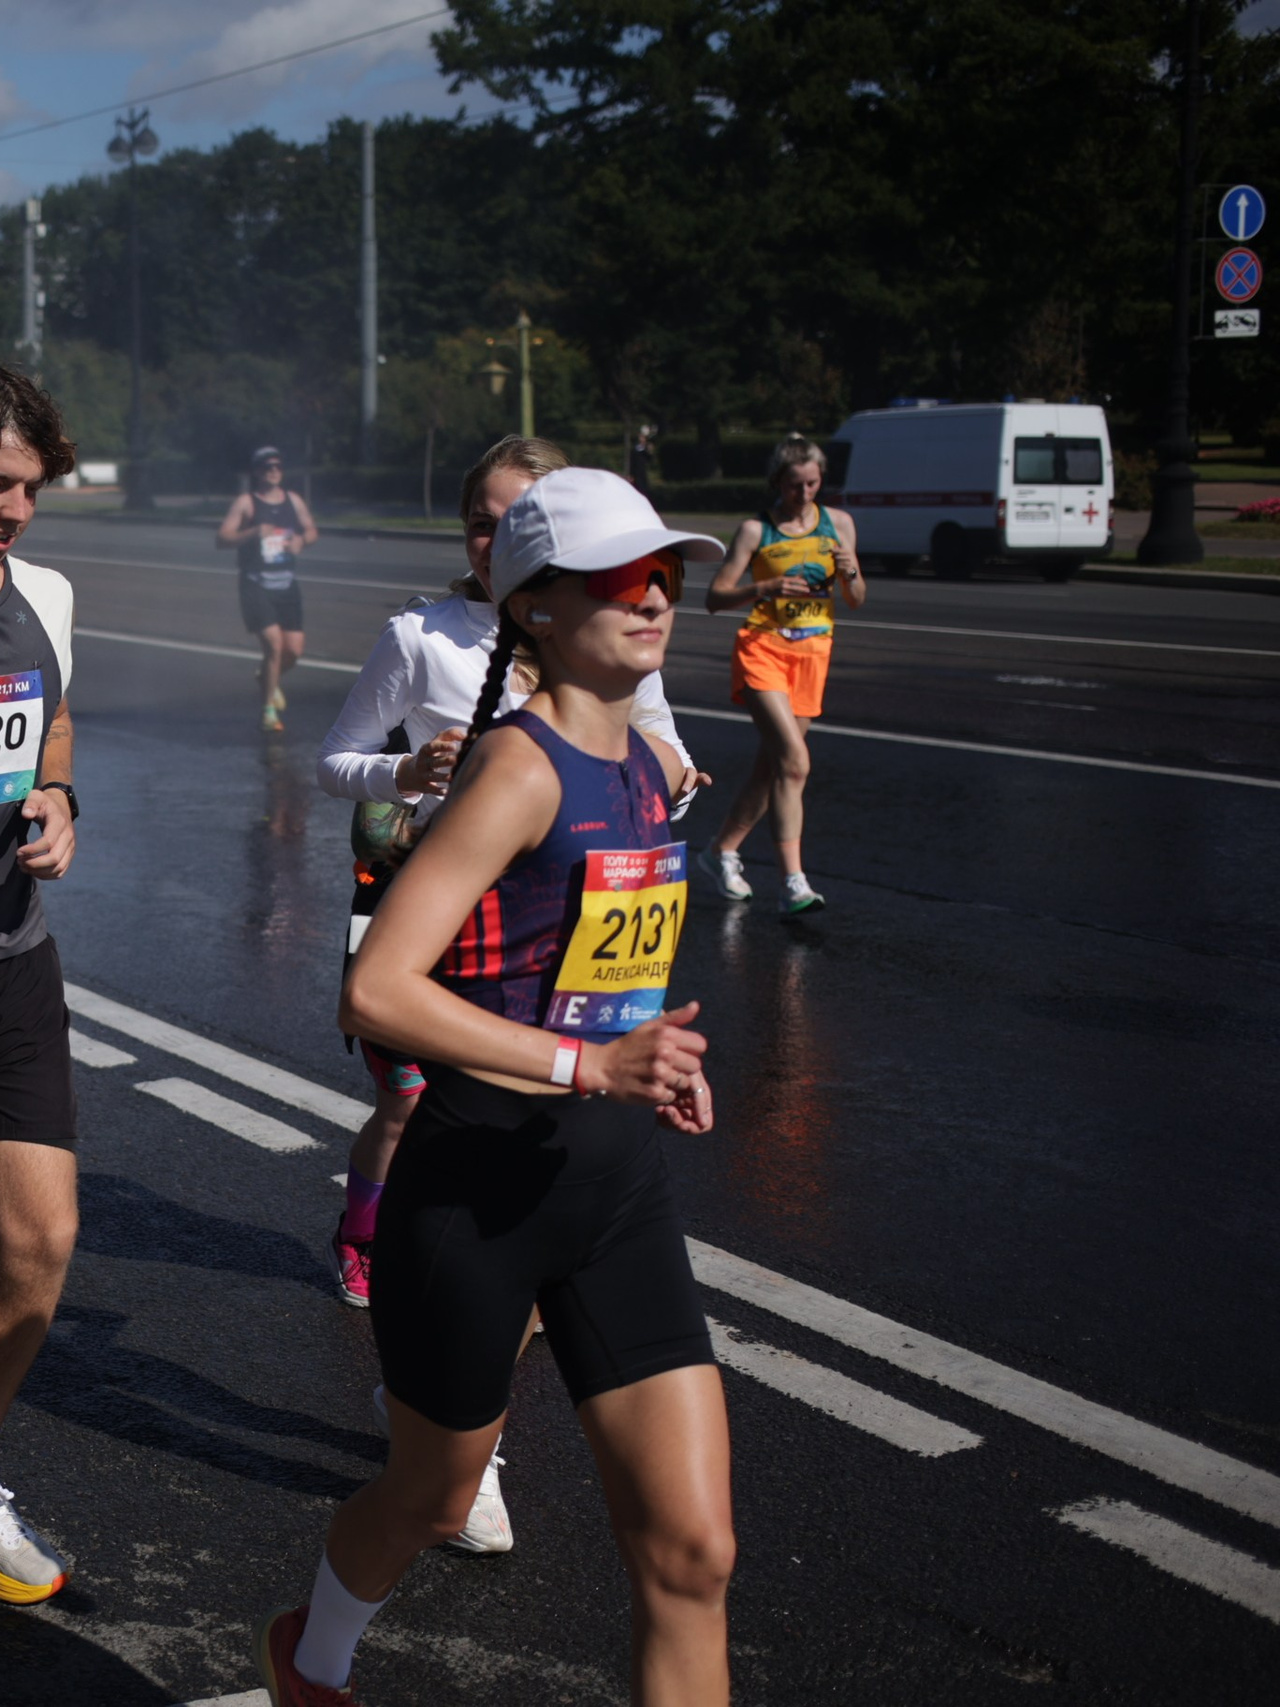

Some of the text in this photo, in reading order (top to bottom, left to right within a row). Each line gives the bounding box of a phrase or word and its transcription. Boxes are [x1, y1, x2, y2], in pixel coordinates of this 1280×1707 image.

[14, 681, 30, 692] КМ
[591, 899, 678, 960] 2131
[563, 996, 588, 1025] E
